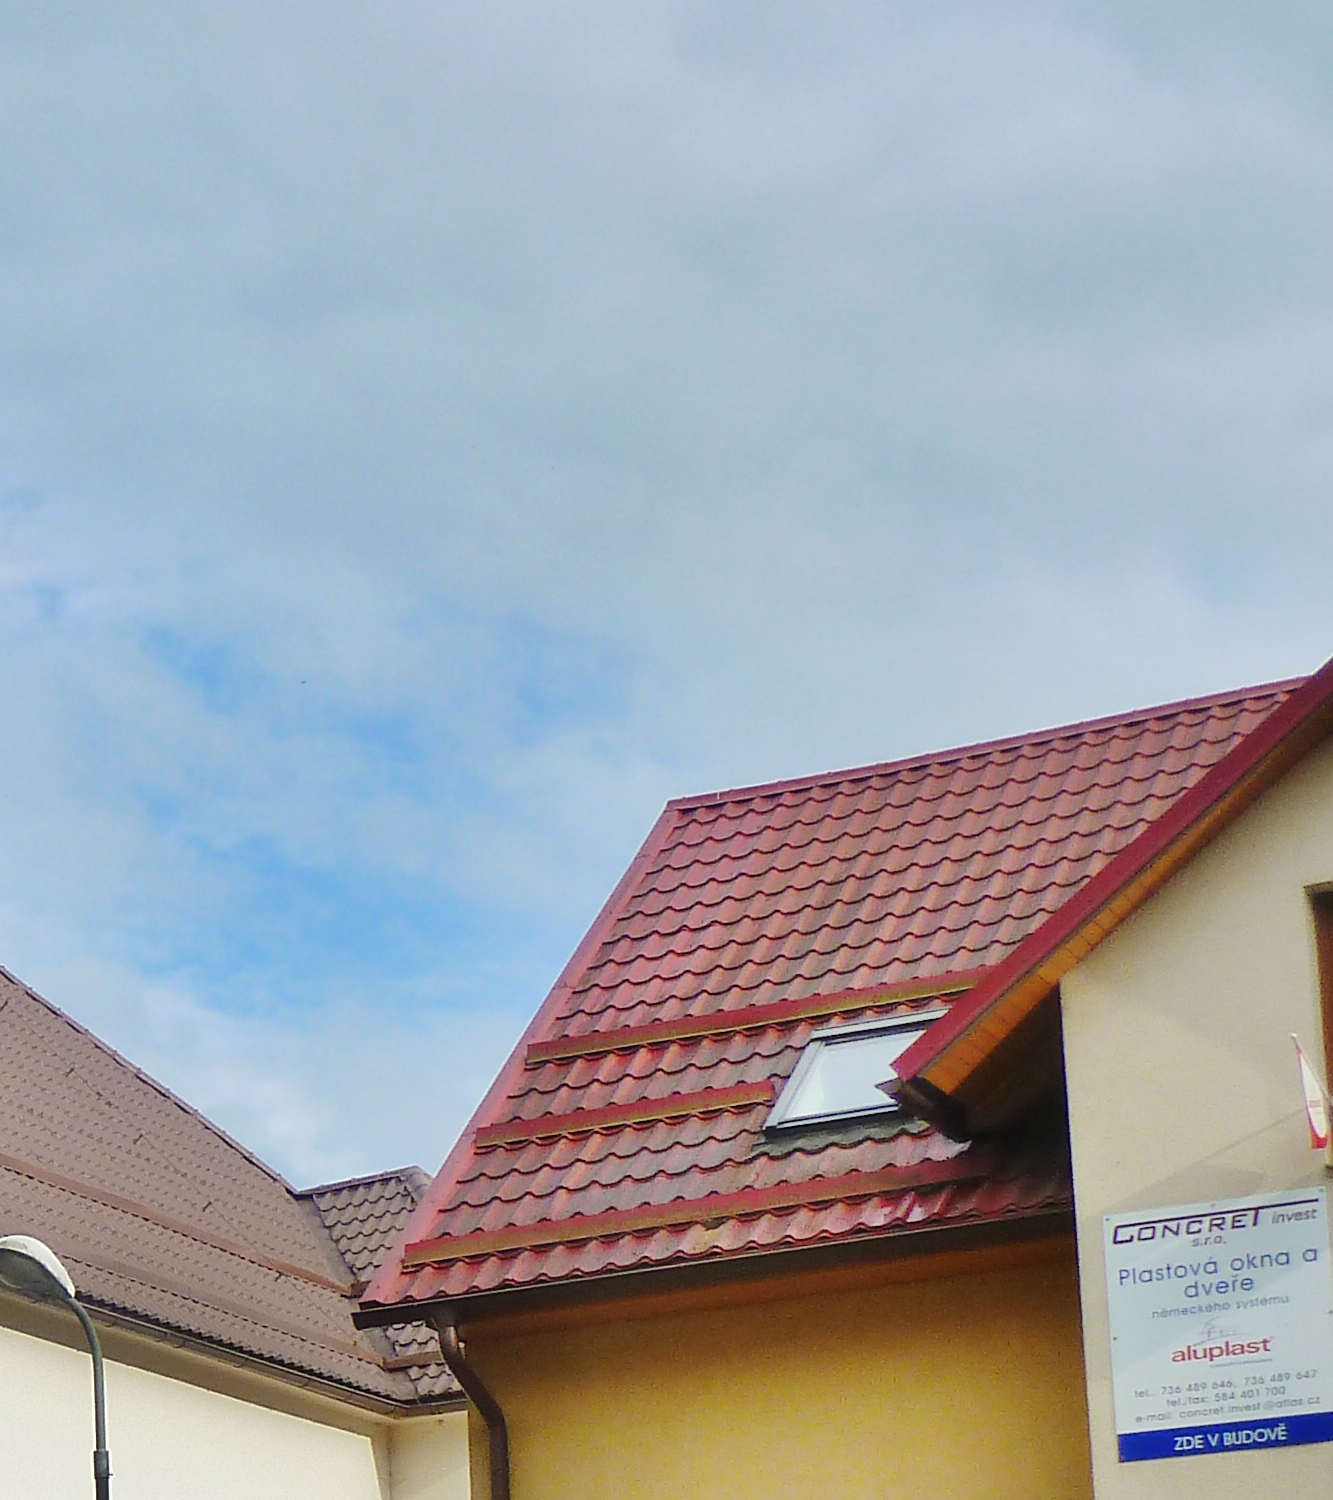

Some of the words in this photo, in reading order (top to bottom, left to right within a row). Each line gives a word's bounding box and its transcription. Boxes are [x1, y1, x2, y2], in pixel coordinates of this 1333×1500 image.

[1112, 1207, 1261, 1245] CONCRET
[1271, 1208, 1318, 1225] invest
[1191, 1235, 1227, 1247] s.r.o.
[1119, 1256, 1218, 1286] Plastová
[1230, 1251, 1290, 1272] okna
[1302, 1248, 1318, 1262] a
[1184, 1275, 1255, 1298] dveře
[1151, 1300, 1230, 1319] německého
[1171, 1337, 1271, 1363] aluplast
[1161, 1385, 1182, 1395] 736
[1244, 1376, 1265, 1387] 736
[1174, 1434, 1204, 1451] ZDE
[1207, 1433, 1219, 1447] V
[1223, 1423, 1288, 1446] BUDOVĚ
